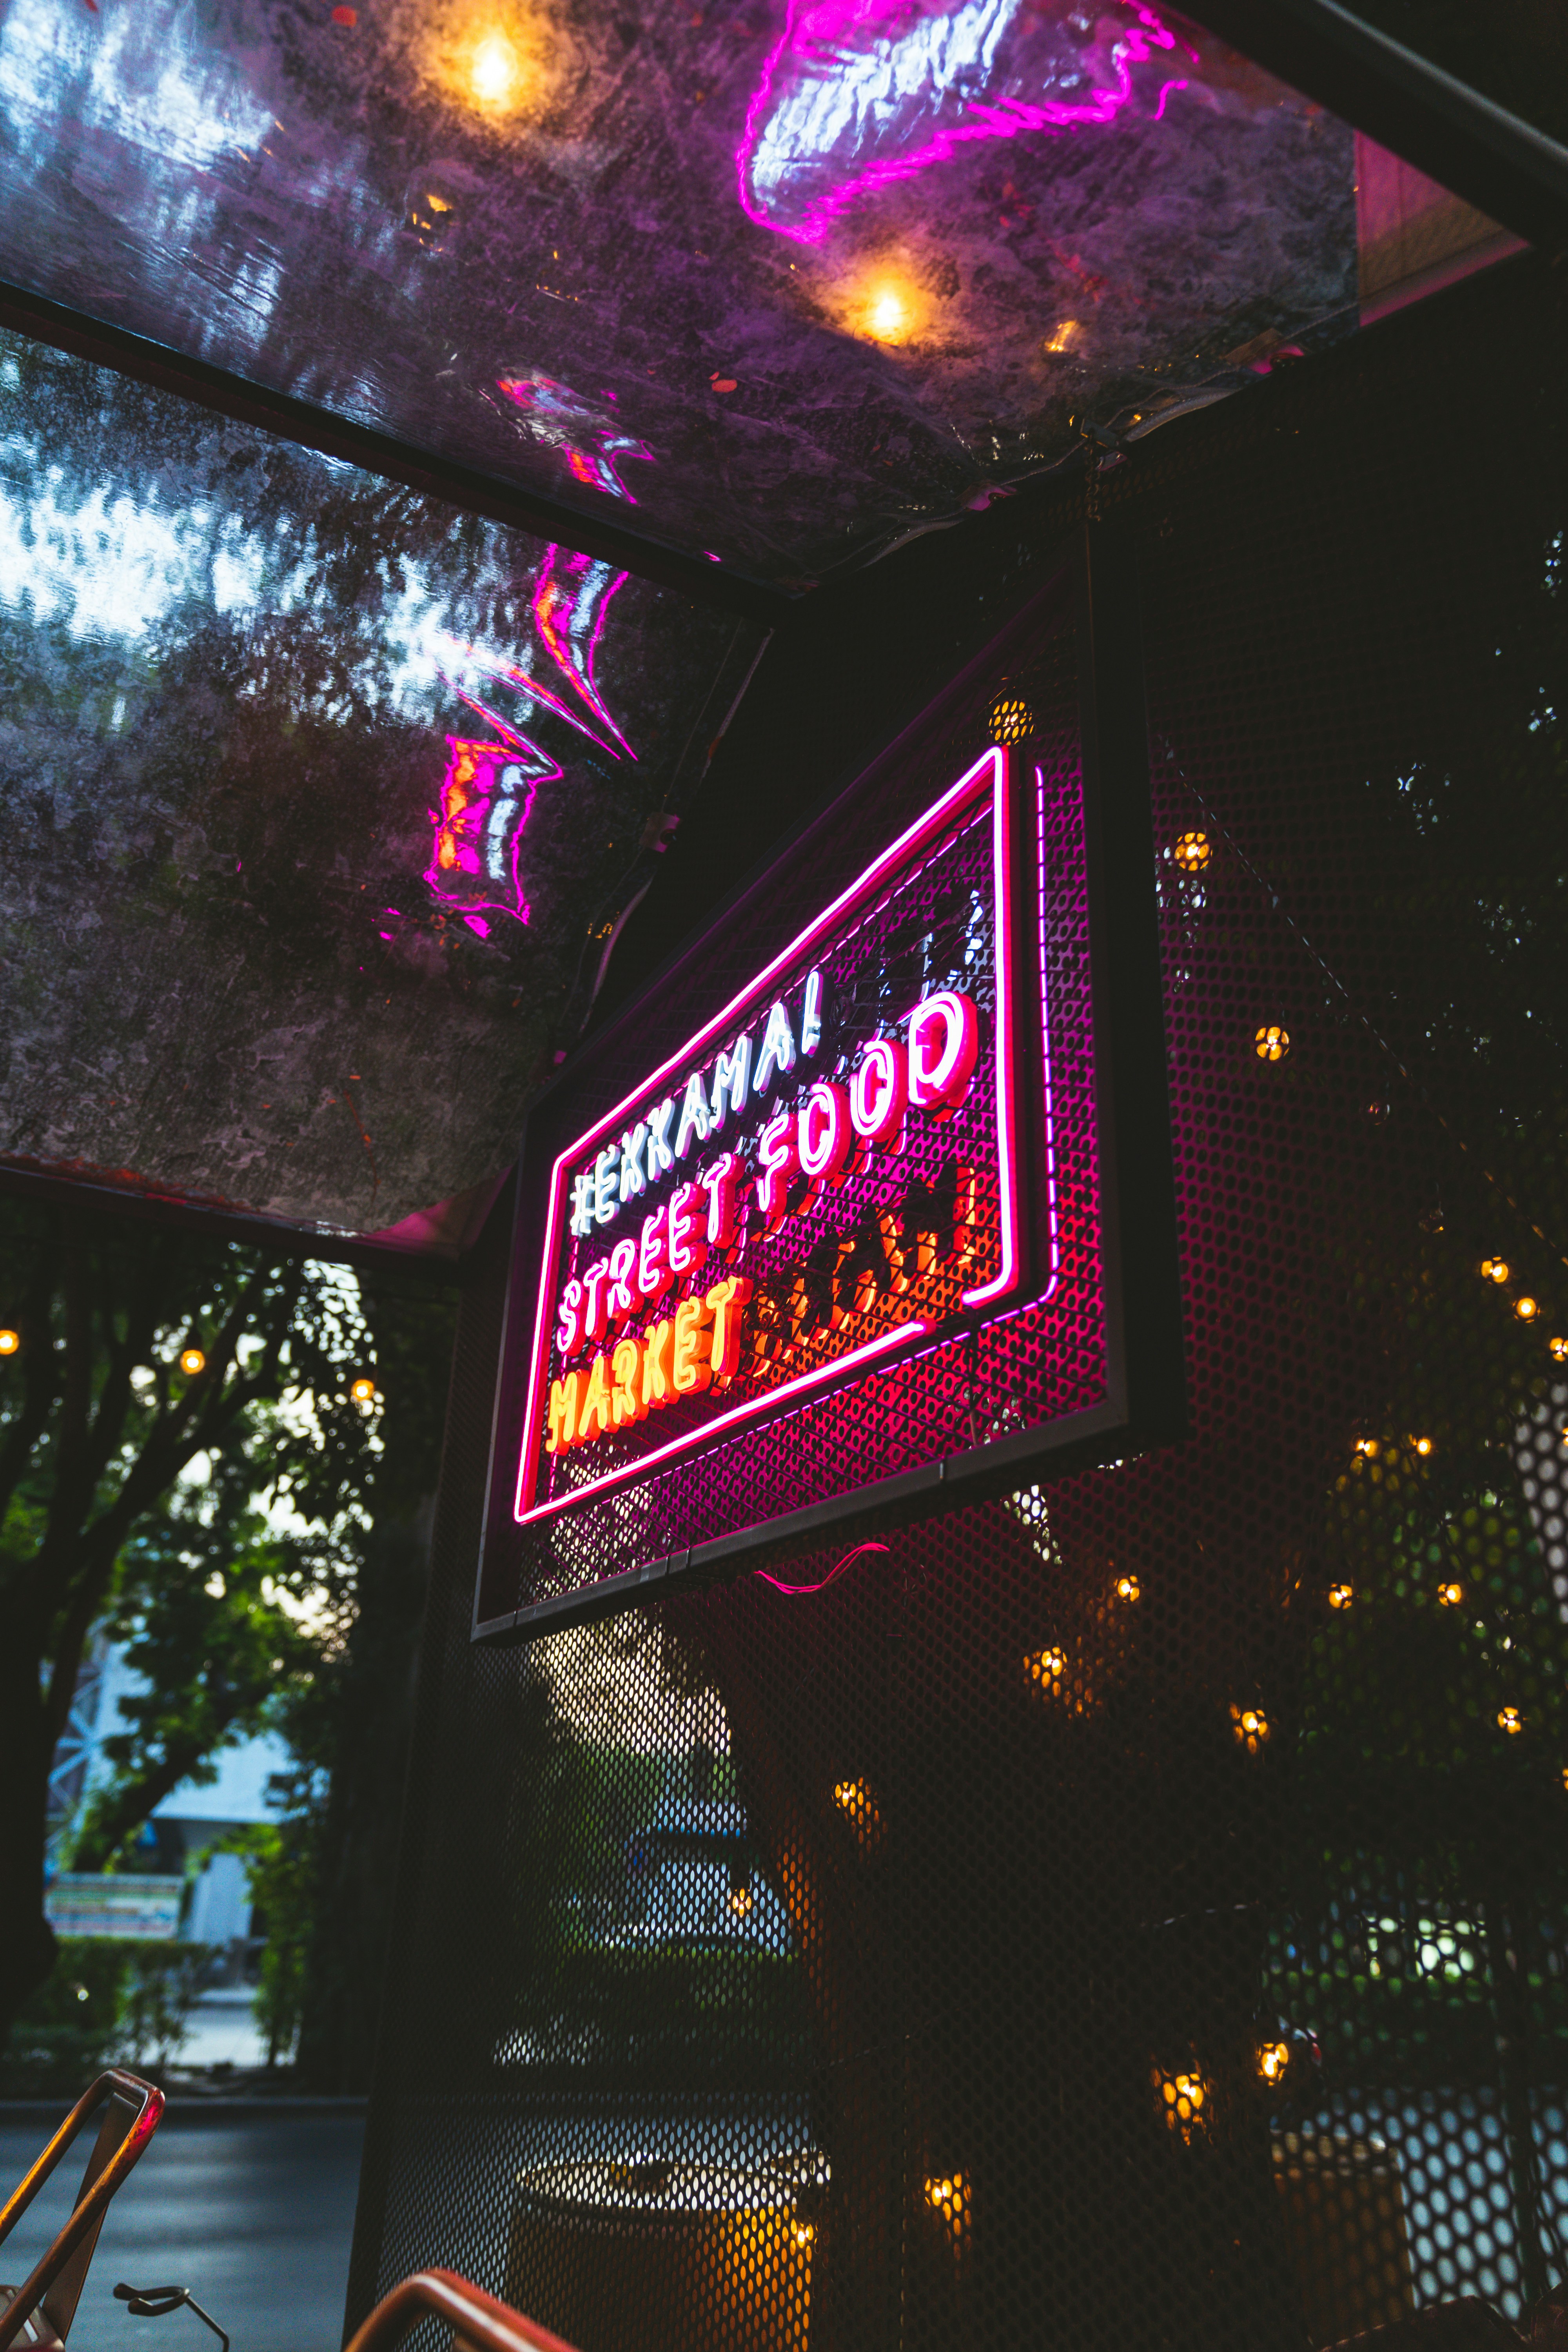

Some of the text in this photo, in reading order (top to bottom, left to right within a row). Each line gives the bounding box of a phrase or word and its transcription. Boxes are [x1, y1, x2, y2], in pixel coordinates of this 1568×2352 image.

[556, 991, 975, 1355] STREET FOOD
[546, 1275, 750, 1454] MARKET
